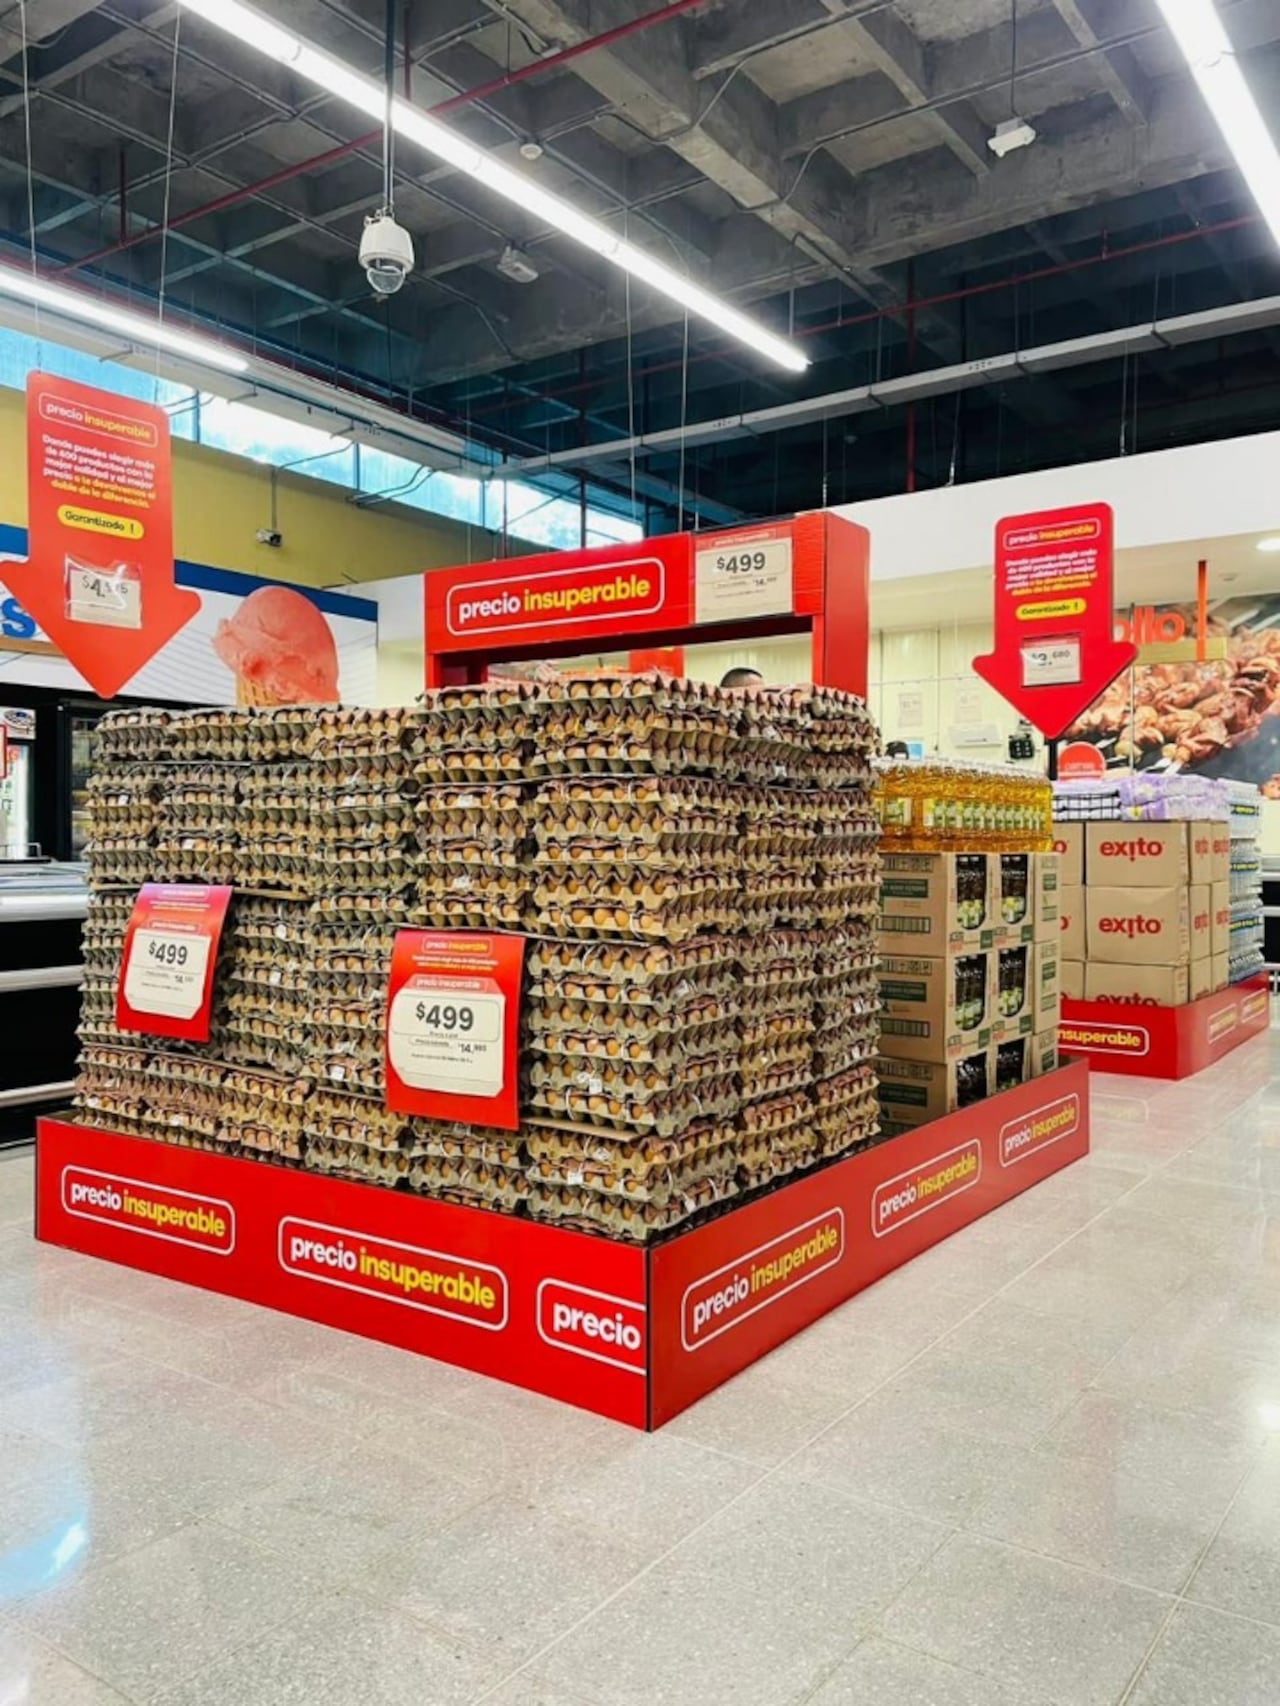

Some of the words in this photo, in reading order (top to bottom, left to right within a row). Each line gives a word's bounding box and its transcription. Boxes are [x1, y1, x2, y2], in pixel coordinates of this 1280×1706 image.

[46, 404, 83, 421] precio
[84, 411, 151, 438] insuperable
[64, 510, 125, 532] Garantizado
[1008, 532, 1039, 546] precio
[1038, 524, 1095, 541] insuperable
[716, 551, 767, 574] $499
[458, 592, 521, 625] precio
[524, 574, 650, 612] insuperable
[1099, 837, 1164, 862] exito
[1098, 914, 1163, 939] exito
[148, 939, 189, 967] $499
[415, 1001, 475, 1032] $499
[1004, 1124, 1032, 1157] precio
[1031, 1104, 1076, 1138] insuperable
[879, 1182, 917, 1225] precio
[916, 1151, 977, 1200] insuperable
[71, 1182, 122, 1211] precio
[122, 1189, 226, 1238] insuperable
[290, 1236, 357, 1272] precio
[359, 1247, 496, 1309] insuperable
[693, 1273, 750, 1335] precio
[750, 1224, 839, 1293] insuperable
[552, 1302, 641, 1351] precio
